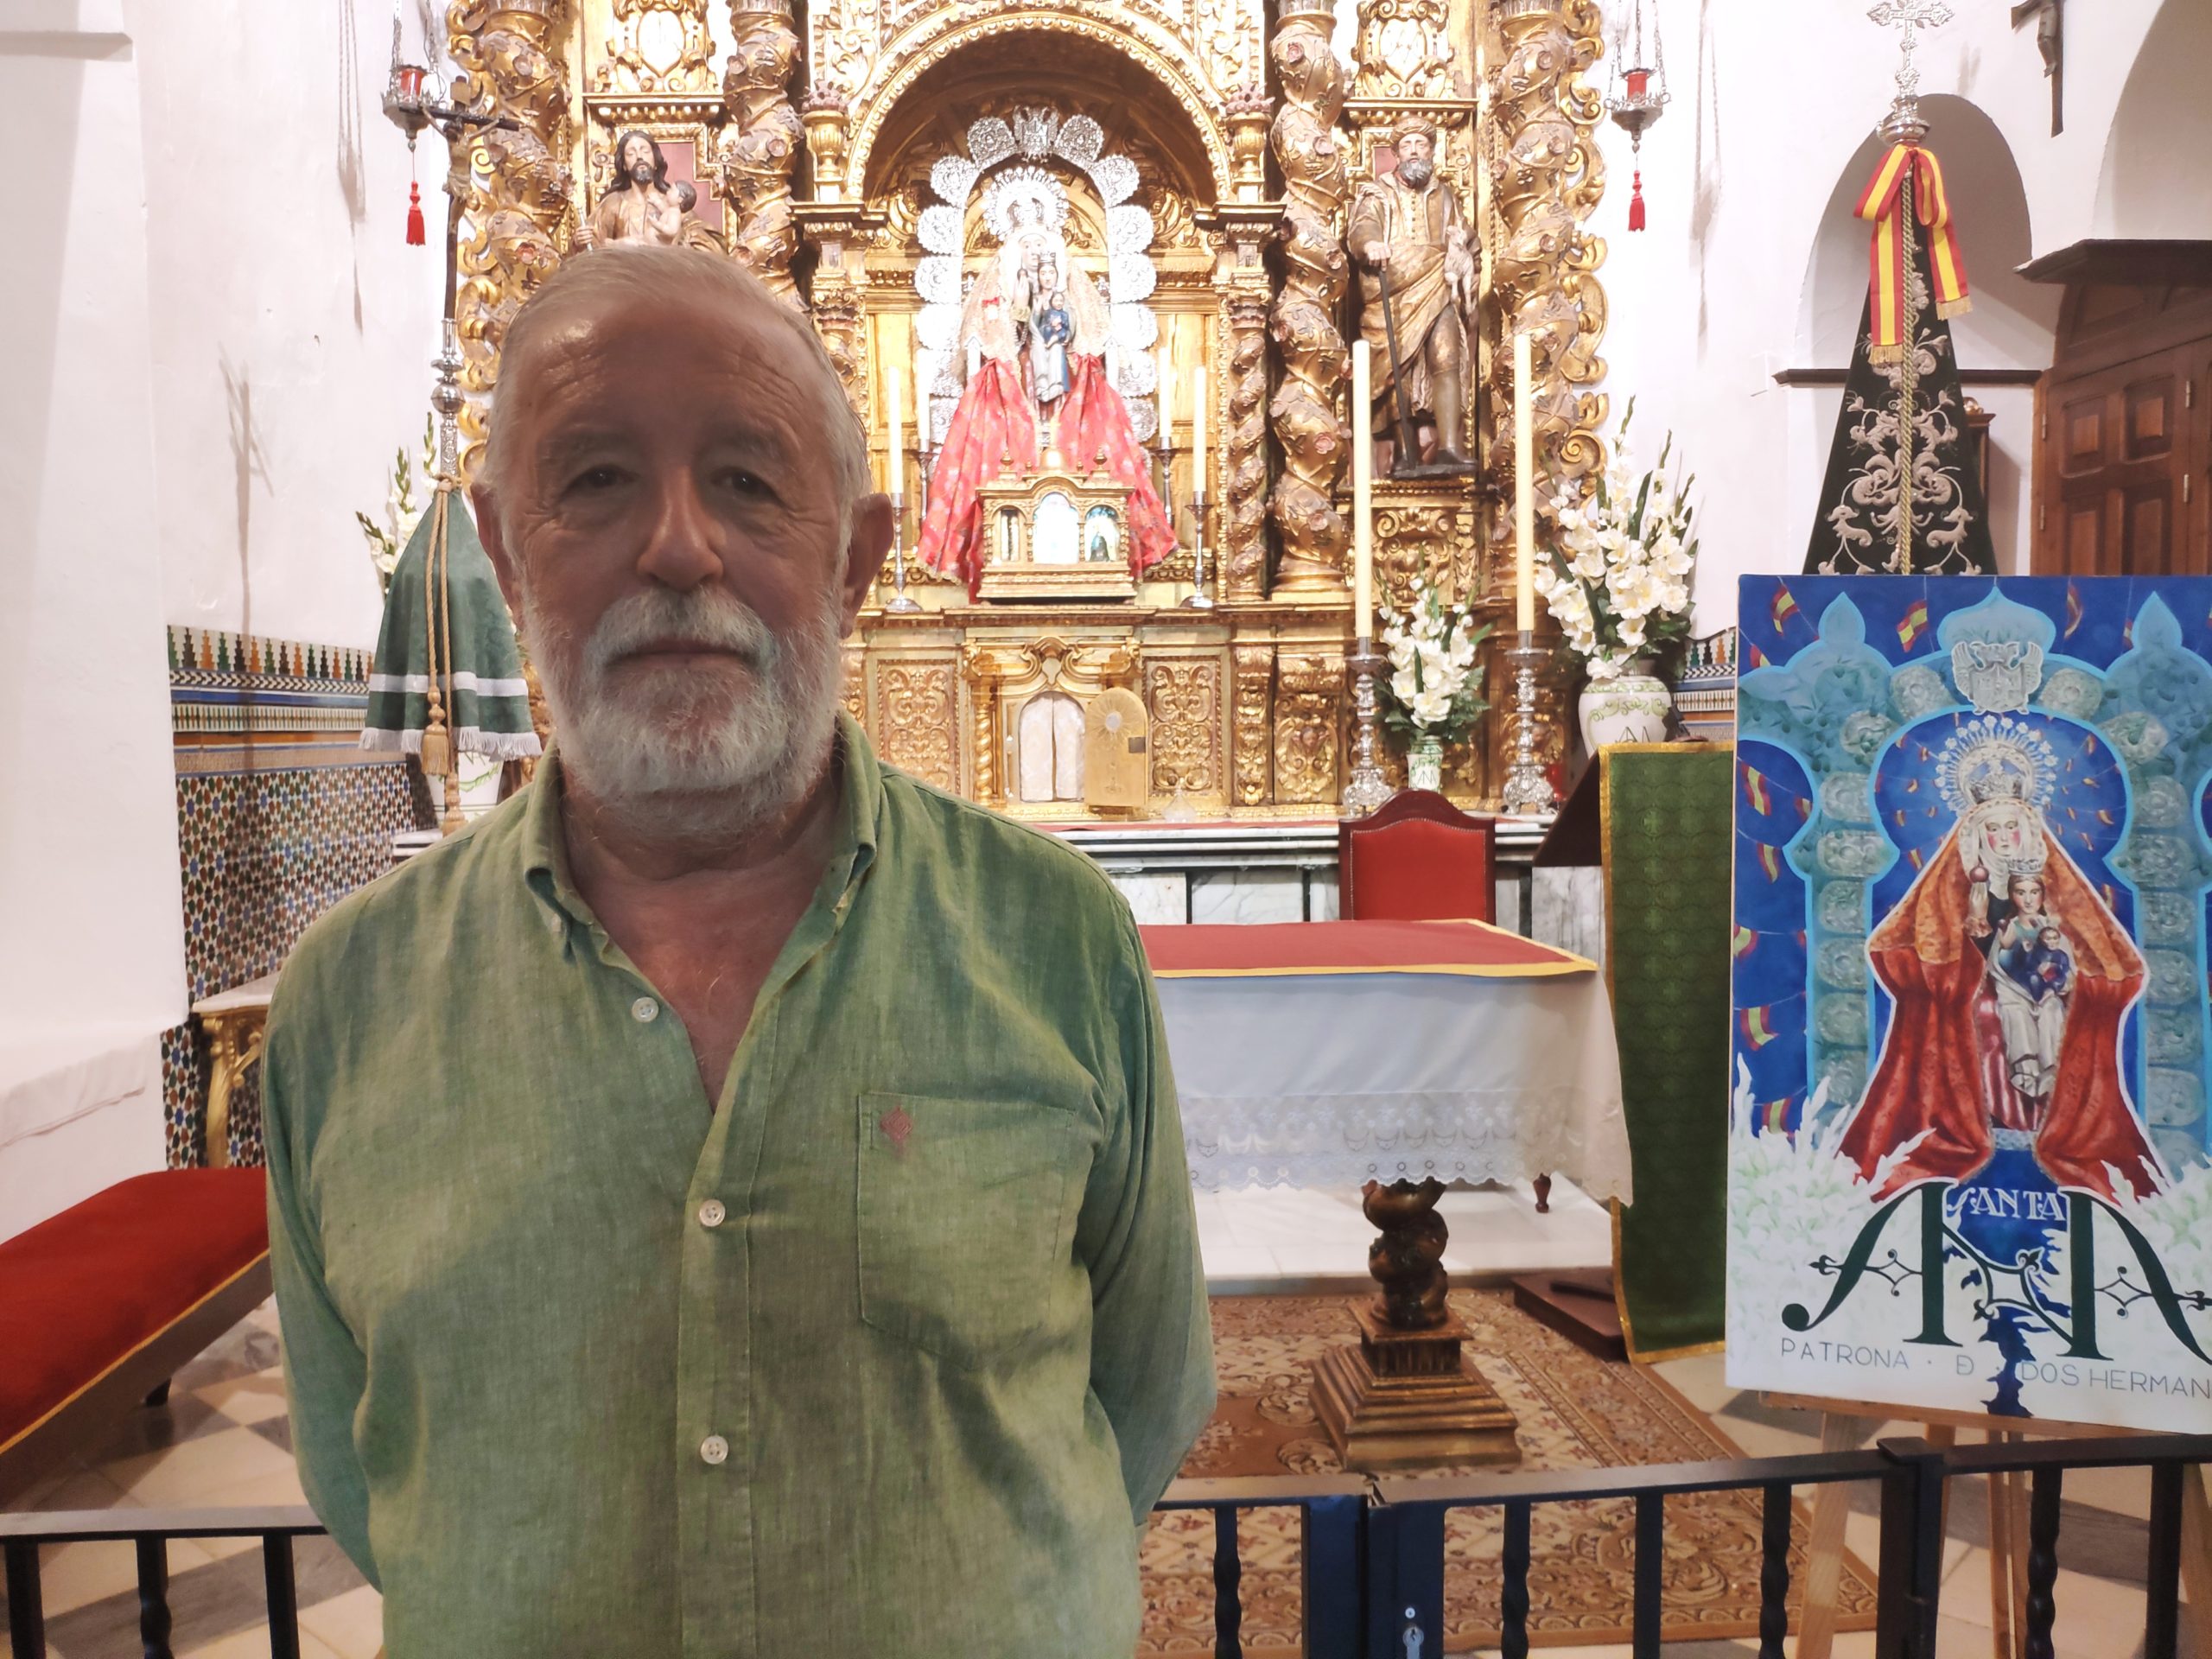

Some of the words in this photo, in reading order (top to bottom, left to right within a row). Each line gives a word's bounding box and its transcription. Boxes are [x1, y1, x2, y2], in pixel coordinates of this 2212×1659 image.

[1947, 1186, 2067, 1221] SANTA
[1781, 1338, 1910, 1370] PATRONA
[2021, 1361, 2080, 1387] DOS
